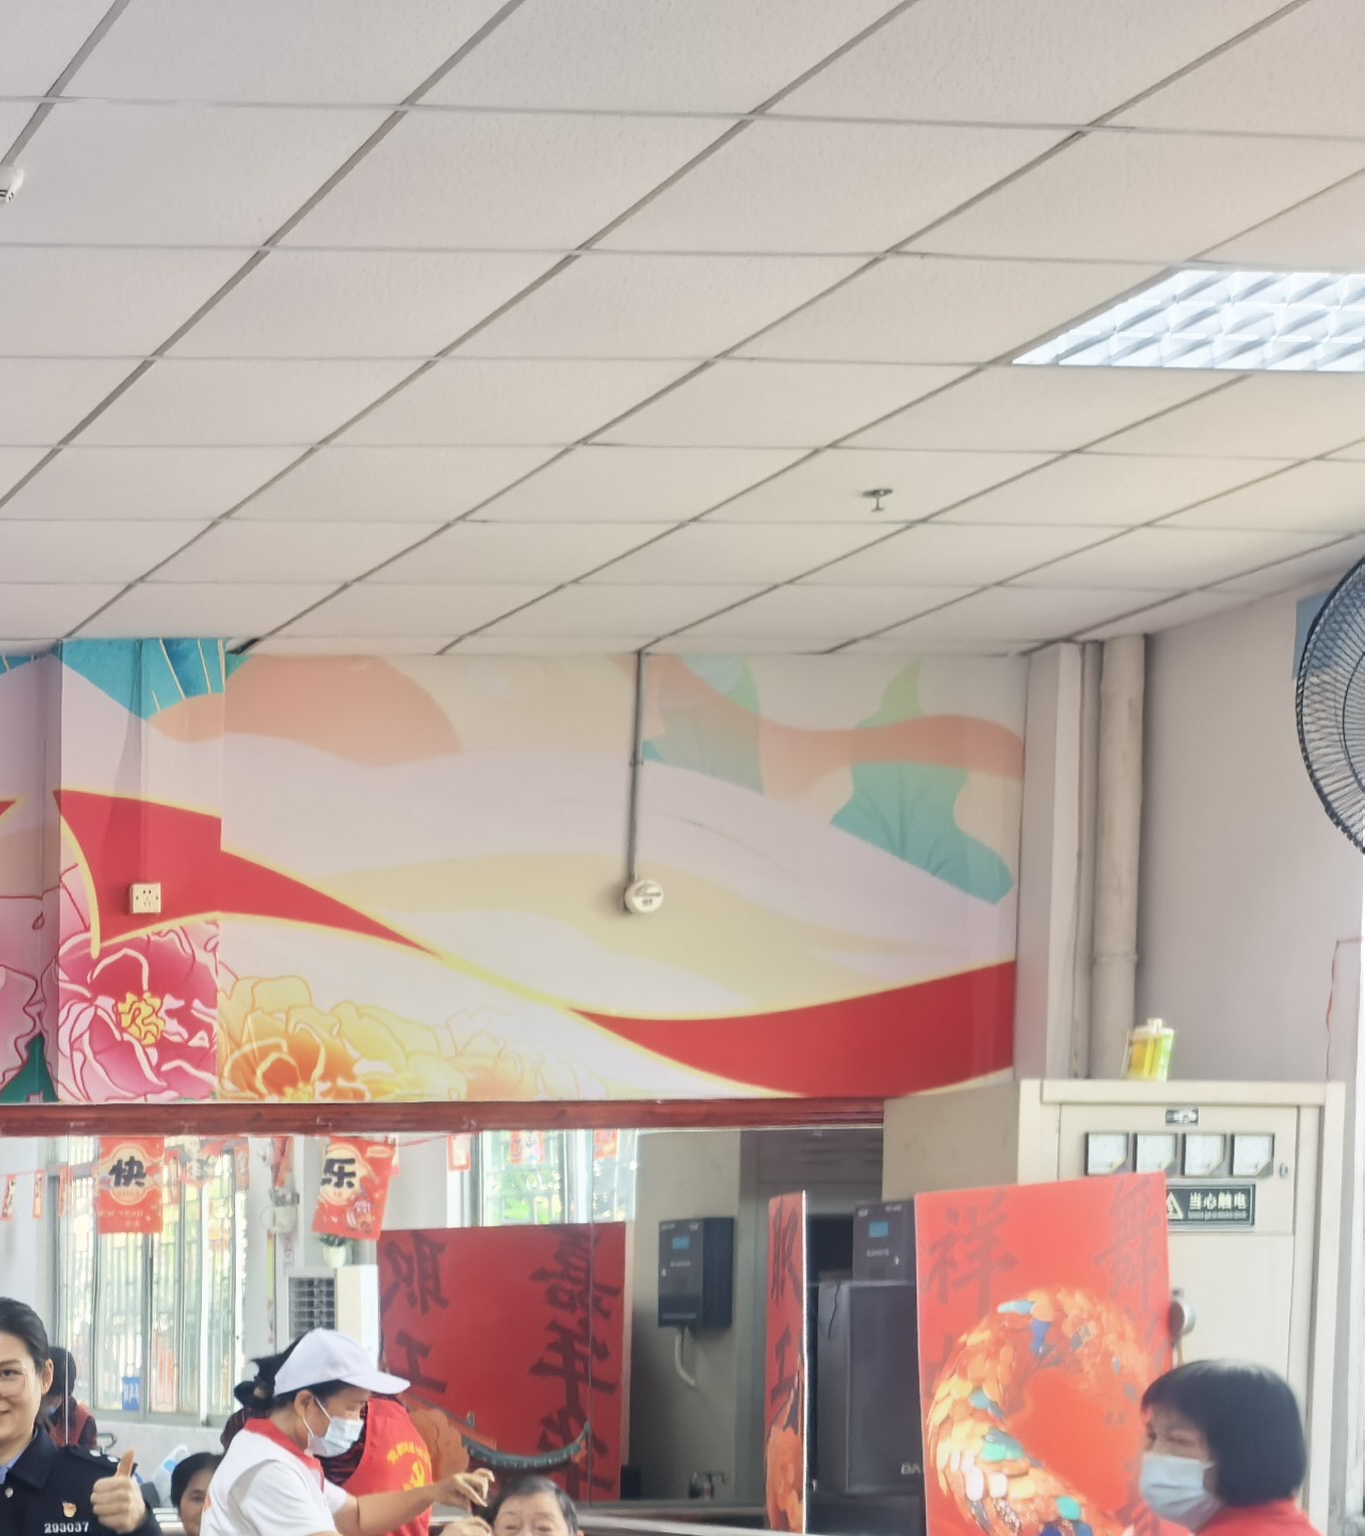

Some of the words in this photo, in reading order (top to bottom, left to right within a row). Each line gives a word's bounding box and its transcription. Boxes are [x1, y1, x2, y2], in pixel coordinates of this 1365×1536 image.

[108, 1155, 147, 1188] 快
[320, 1157, 357, 1188] 乐
[1188, 1190, 1248, 1210] 当心触电
